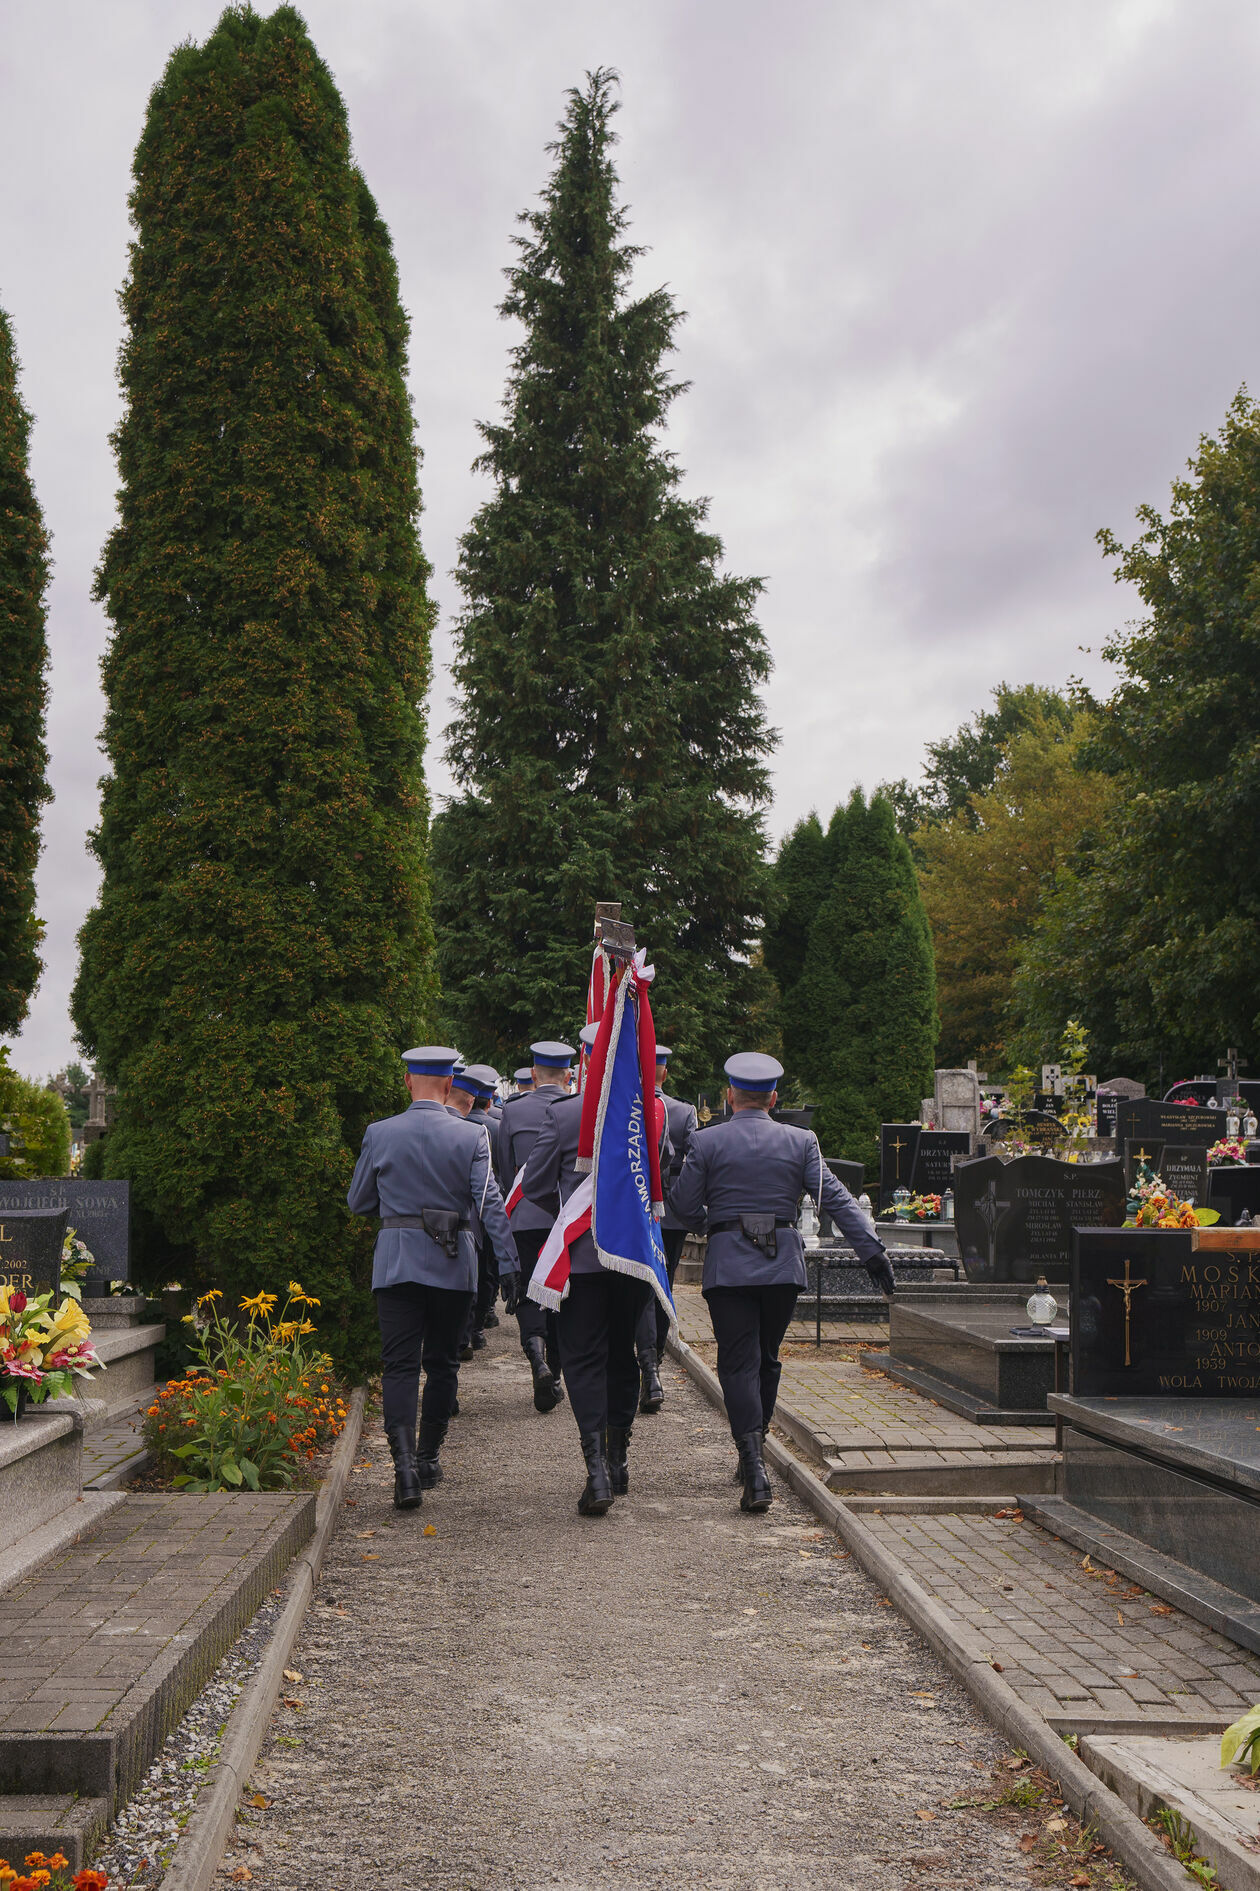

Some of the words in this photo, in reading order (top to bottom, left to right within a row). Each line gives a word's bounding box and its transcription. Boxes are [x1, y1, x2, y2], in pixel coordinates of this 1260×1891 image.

[628, 1092, 653, 1225] AMORZĄDNY
[1016, 1188, 1065, 1199] TOMCZYK
[1195, 1300, 1227, 1312] 1907
[1196, 1328, 1228, 1341] 1909
[1195, 1358, 1227, 1370] 1939
[1159, 1375, 1203, 1388] WOLA
